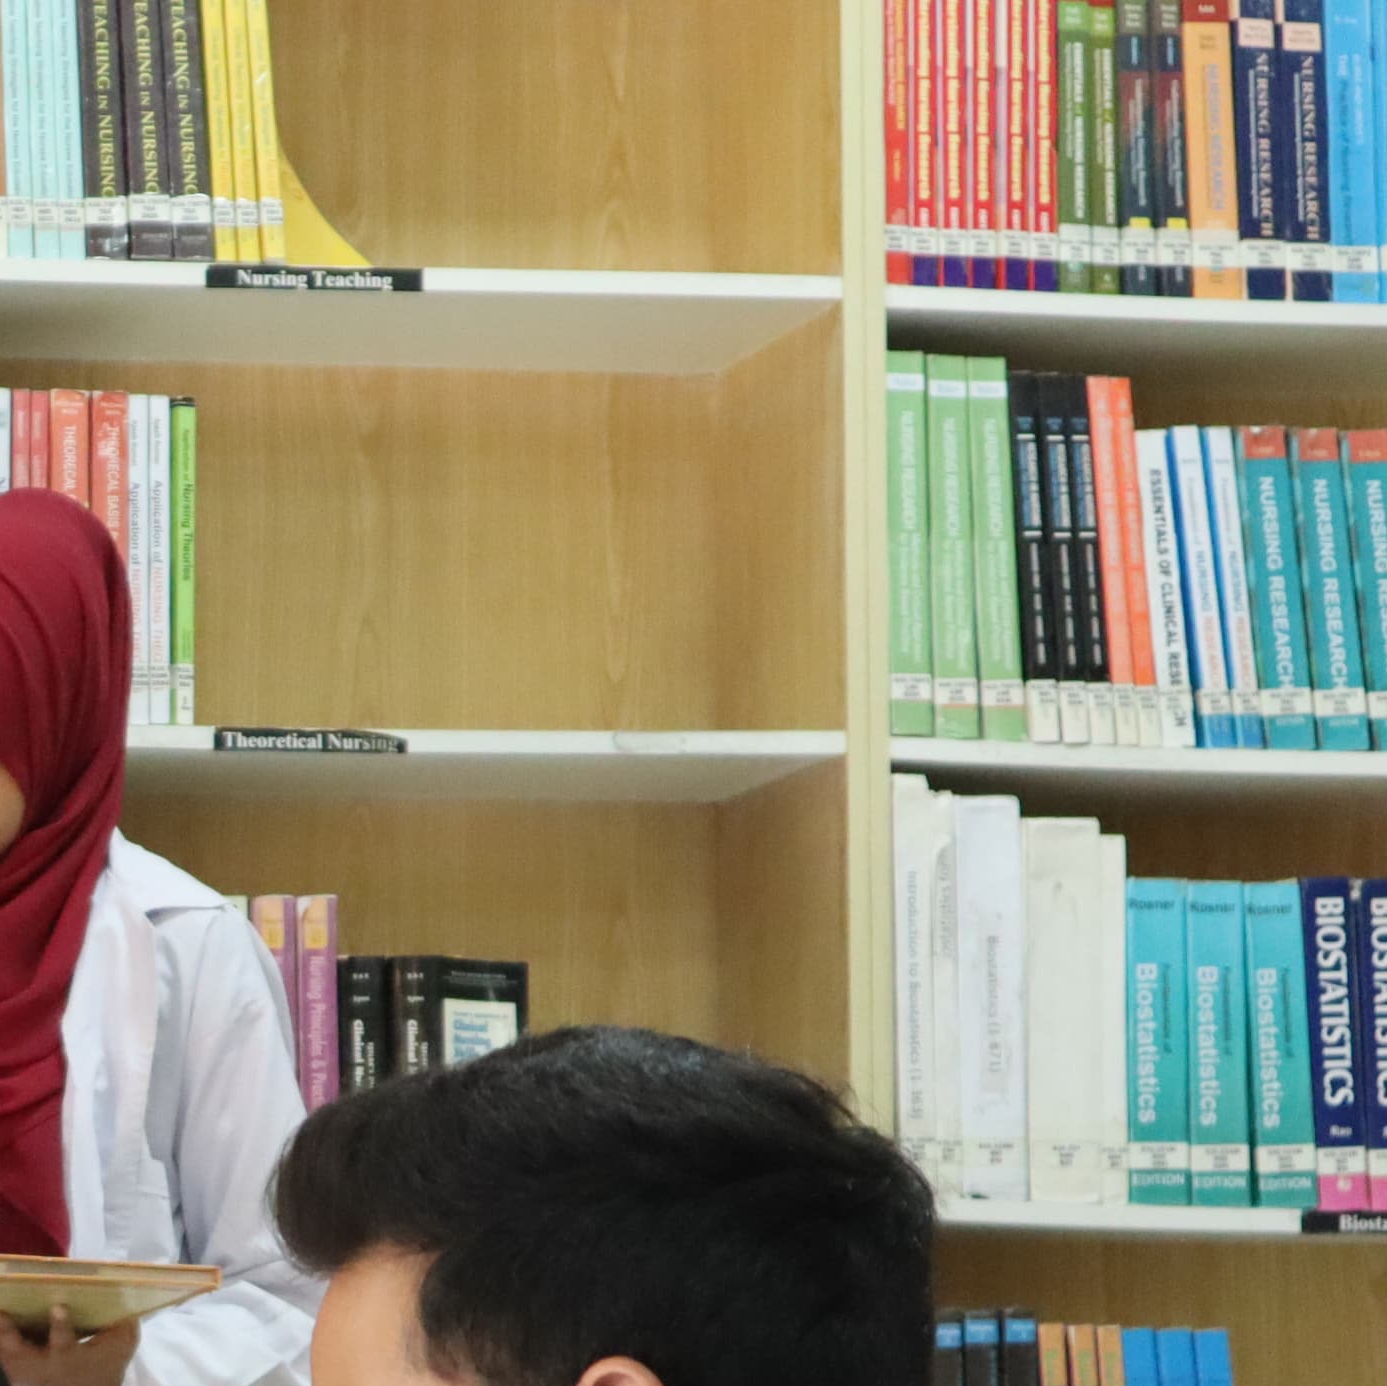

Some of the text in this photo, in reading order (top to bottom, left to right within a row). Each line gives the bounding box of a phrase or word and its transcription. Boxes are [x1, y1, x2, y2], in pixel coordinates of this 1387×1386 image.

[1256, 53, 1274, 236] NURSING RESEARCH
[1301, 55, 1319, 240] NURSING RESEARCH
[237, 269, 393, 290] Nursing Teaching
[180, 484, 194, 580] Nursing Theories
[222, 731, 399, 752] Theoretical Nursing
[906, 871, 923, 1065] Introduction to Biostatistics
[1136, 962, 1160, 1123] Biostatistics
[1197, 965, 1220, 1124] Biostatistics
[1315, 897, 1354, 1107] BIOSTATISTICS
[1256, 968, 1283, 1128] Biostatistics
[1130, 1175, 1186, 1188] EDITION
[1193, 1175, 1247, 1189] EDITION
[1260, 1175, 1311, 1190] EDITION
